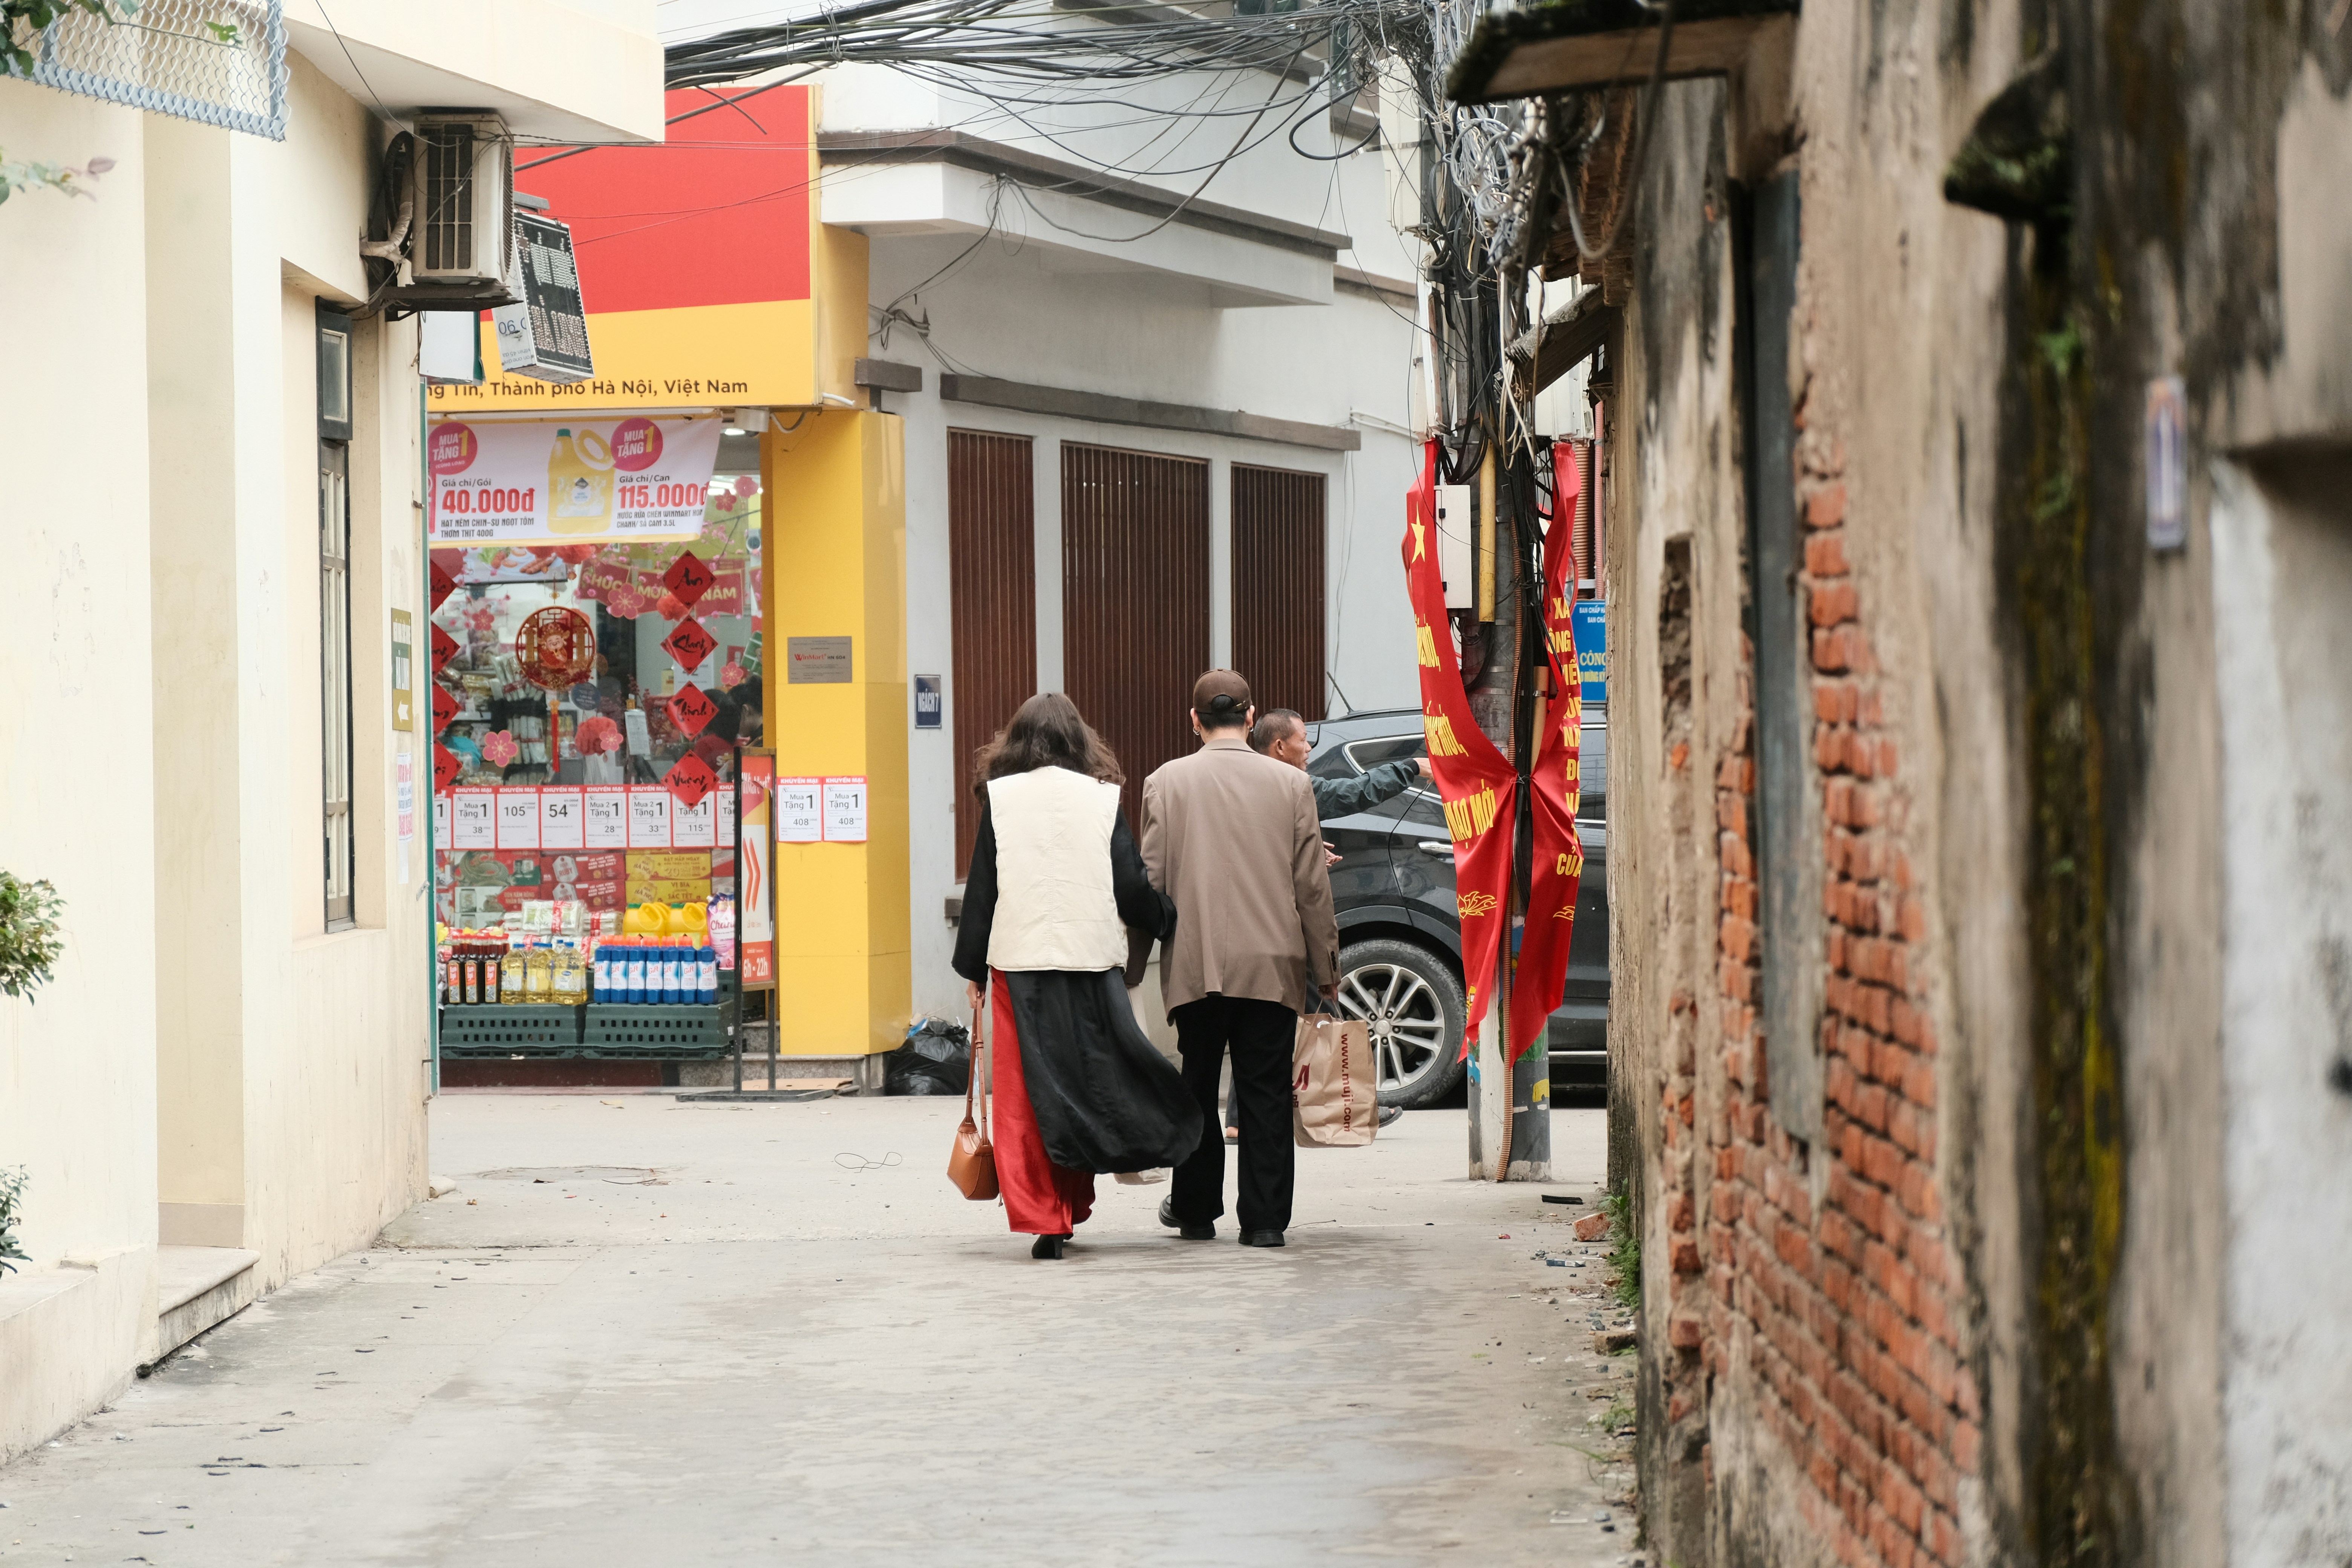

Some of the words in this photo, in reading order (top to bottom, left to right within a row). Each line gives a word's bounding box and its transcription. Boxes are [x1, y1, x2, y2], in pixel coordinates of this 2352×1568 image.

[490, 381, 544, 396] Thành
[592, 380, 615, 394] Hà
[622, 379, 657, 398] Nội,
[664, 379, 700, 397] Việt
[707, 380, 747, 393] Nam
[439, 433, 459, 446] MUA
[624, 429, 644, 442] MUA
[644, 426, 654, 453] 1
[458, 429, 469, 457] 1
[617, 442, 644, 458] TẶNG
[432, 446, 459, 462] TẶNG
[442, 479, 456, 487] Giá
[442, 487, 535, 514] 40.000đ
[441, 519, 453, 529] HẠT
[472, 518, 499, 527] CHIN-SU
[502, 518, 518, 527] NGỌT
[520, 516, 534, 525] TÔM
[462, 529, 475, 539] THỊT
[701, 585, 737, 601] NĂM
[918, 688, 934, 712] NGÁCH
[935, 693, 939, 712] 7
[672, 768, 708, 793] Vượng
[784, 801, 804, 810] Tặng
[806, 794, 813, 809] 1
[829, 800, 849, 809] Tặng
[851, 793, 858, 808] 1
[436, 803, 443, 818] 1
[458, 810, 478, 818] Tặng
[480, 803, 487, 818] 1
[504, 806, 525, 816] 105
[549, 804, 568, 818] 54
[590, 808, 609, 817] Tặng
[612, 802, 619, 816] 1
[634, 808, 654, 817] Tặng
[656, 802, 662, 816] 1
[678, 807, 698, 816] Tặng
[700, 801, 707, 815] 1
[648, 965, 659, 974] Gift
[684, 965, 694, 974] Gift
[702, 966, 712, 974] Gift
[743, 959, 751, 978] 6h
[756, 957, 768, 977] 22h
[1341, 1033, 1354, 1132] www.muji.com
